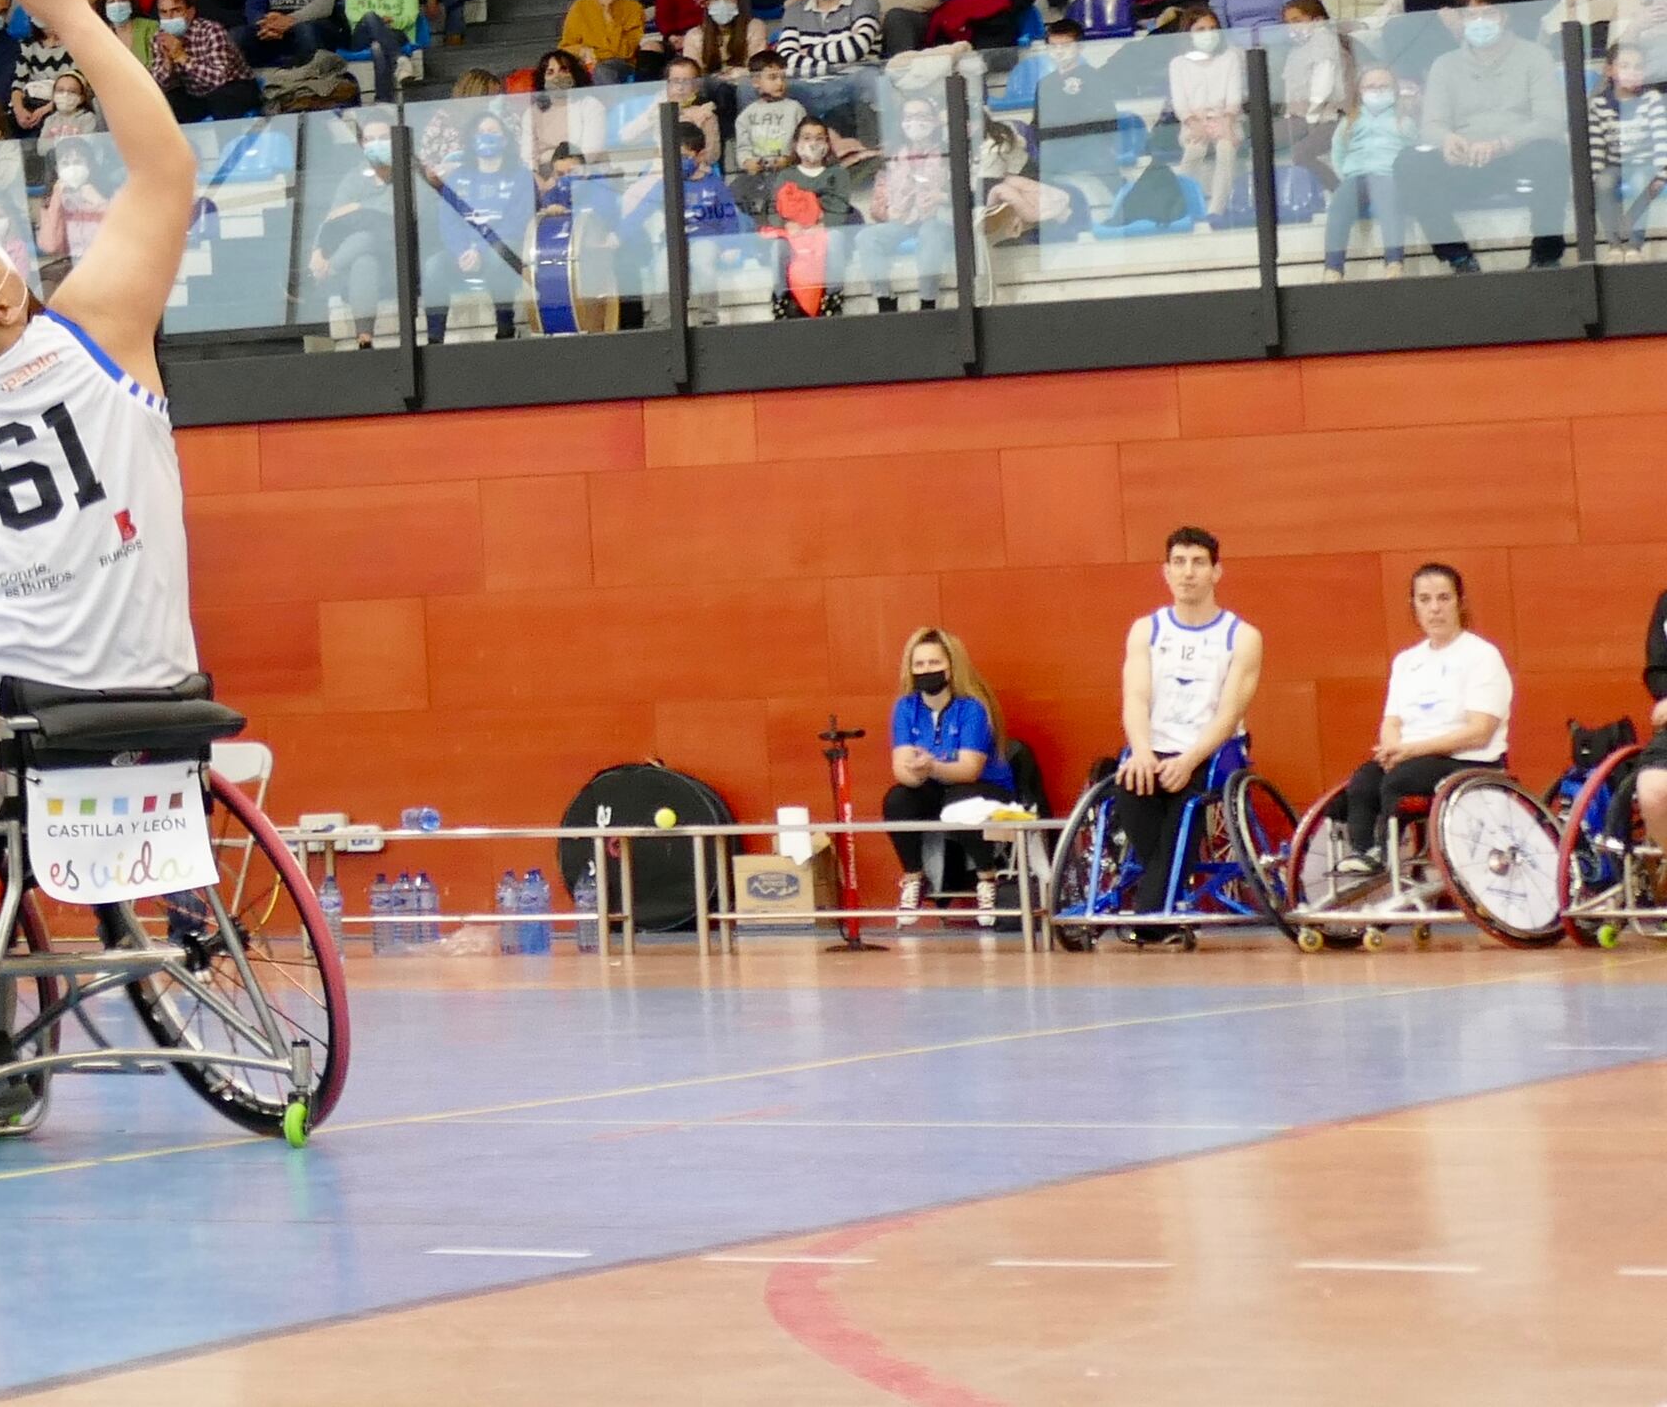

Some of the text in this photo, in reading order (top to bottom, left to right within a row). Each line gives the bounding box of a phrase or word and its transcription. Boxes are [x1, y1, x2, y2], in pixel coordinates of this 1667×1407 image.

[1181, 645, 1195, 660] 12
[48, 815, 186, 837] CASTILLA Y LEÓN
[50, 840, 194, 890] es vida
